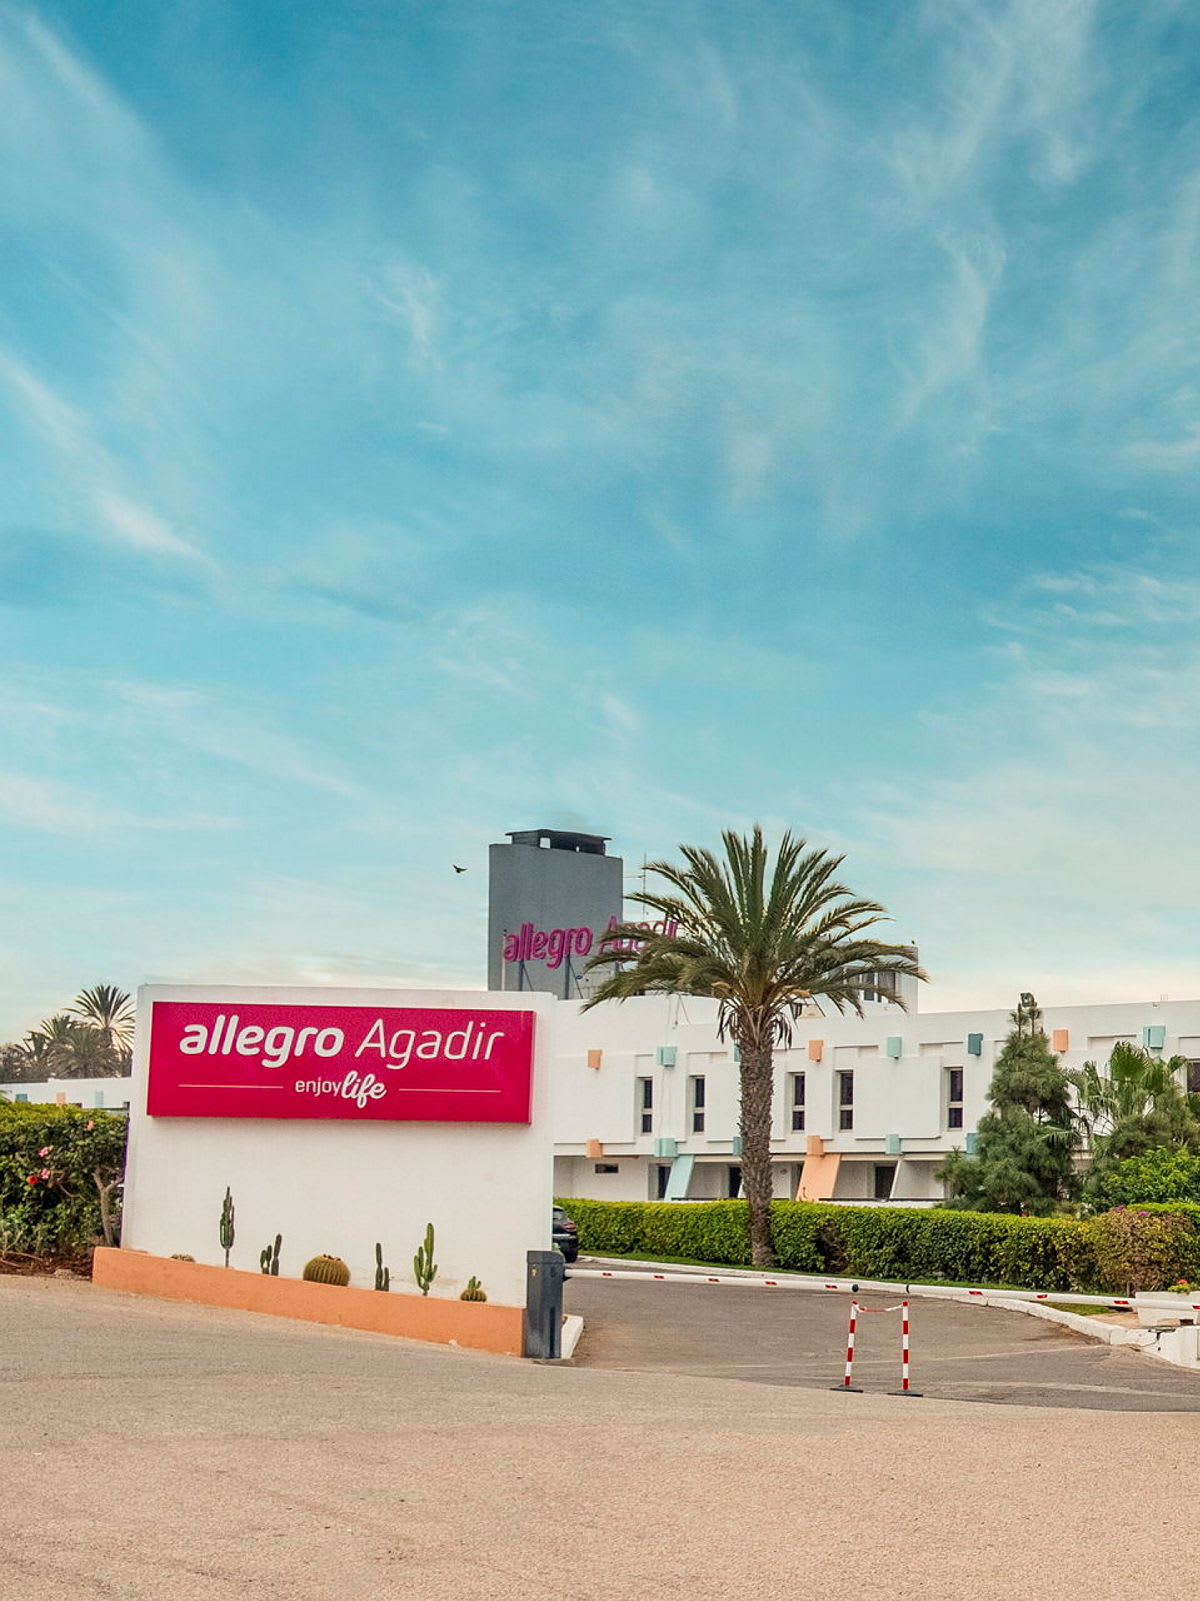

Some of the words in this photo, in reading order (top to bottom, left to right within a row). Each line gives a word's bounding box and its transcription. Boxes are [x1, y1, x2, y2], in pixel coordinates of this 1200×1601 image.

[503, 921, 594, 969] allegro
[179, 1014, 344, 1068] allegro
[355, 1018, 505, 1070] Agadir
